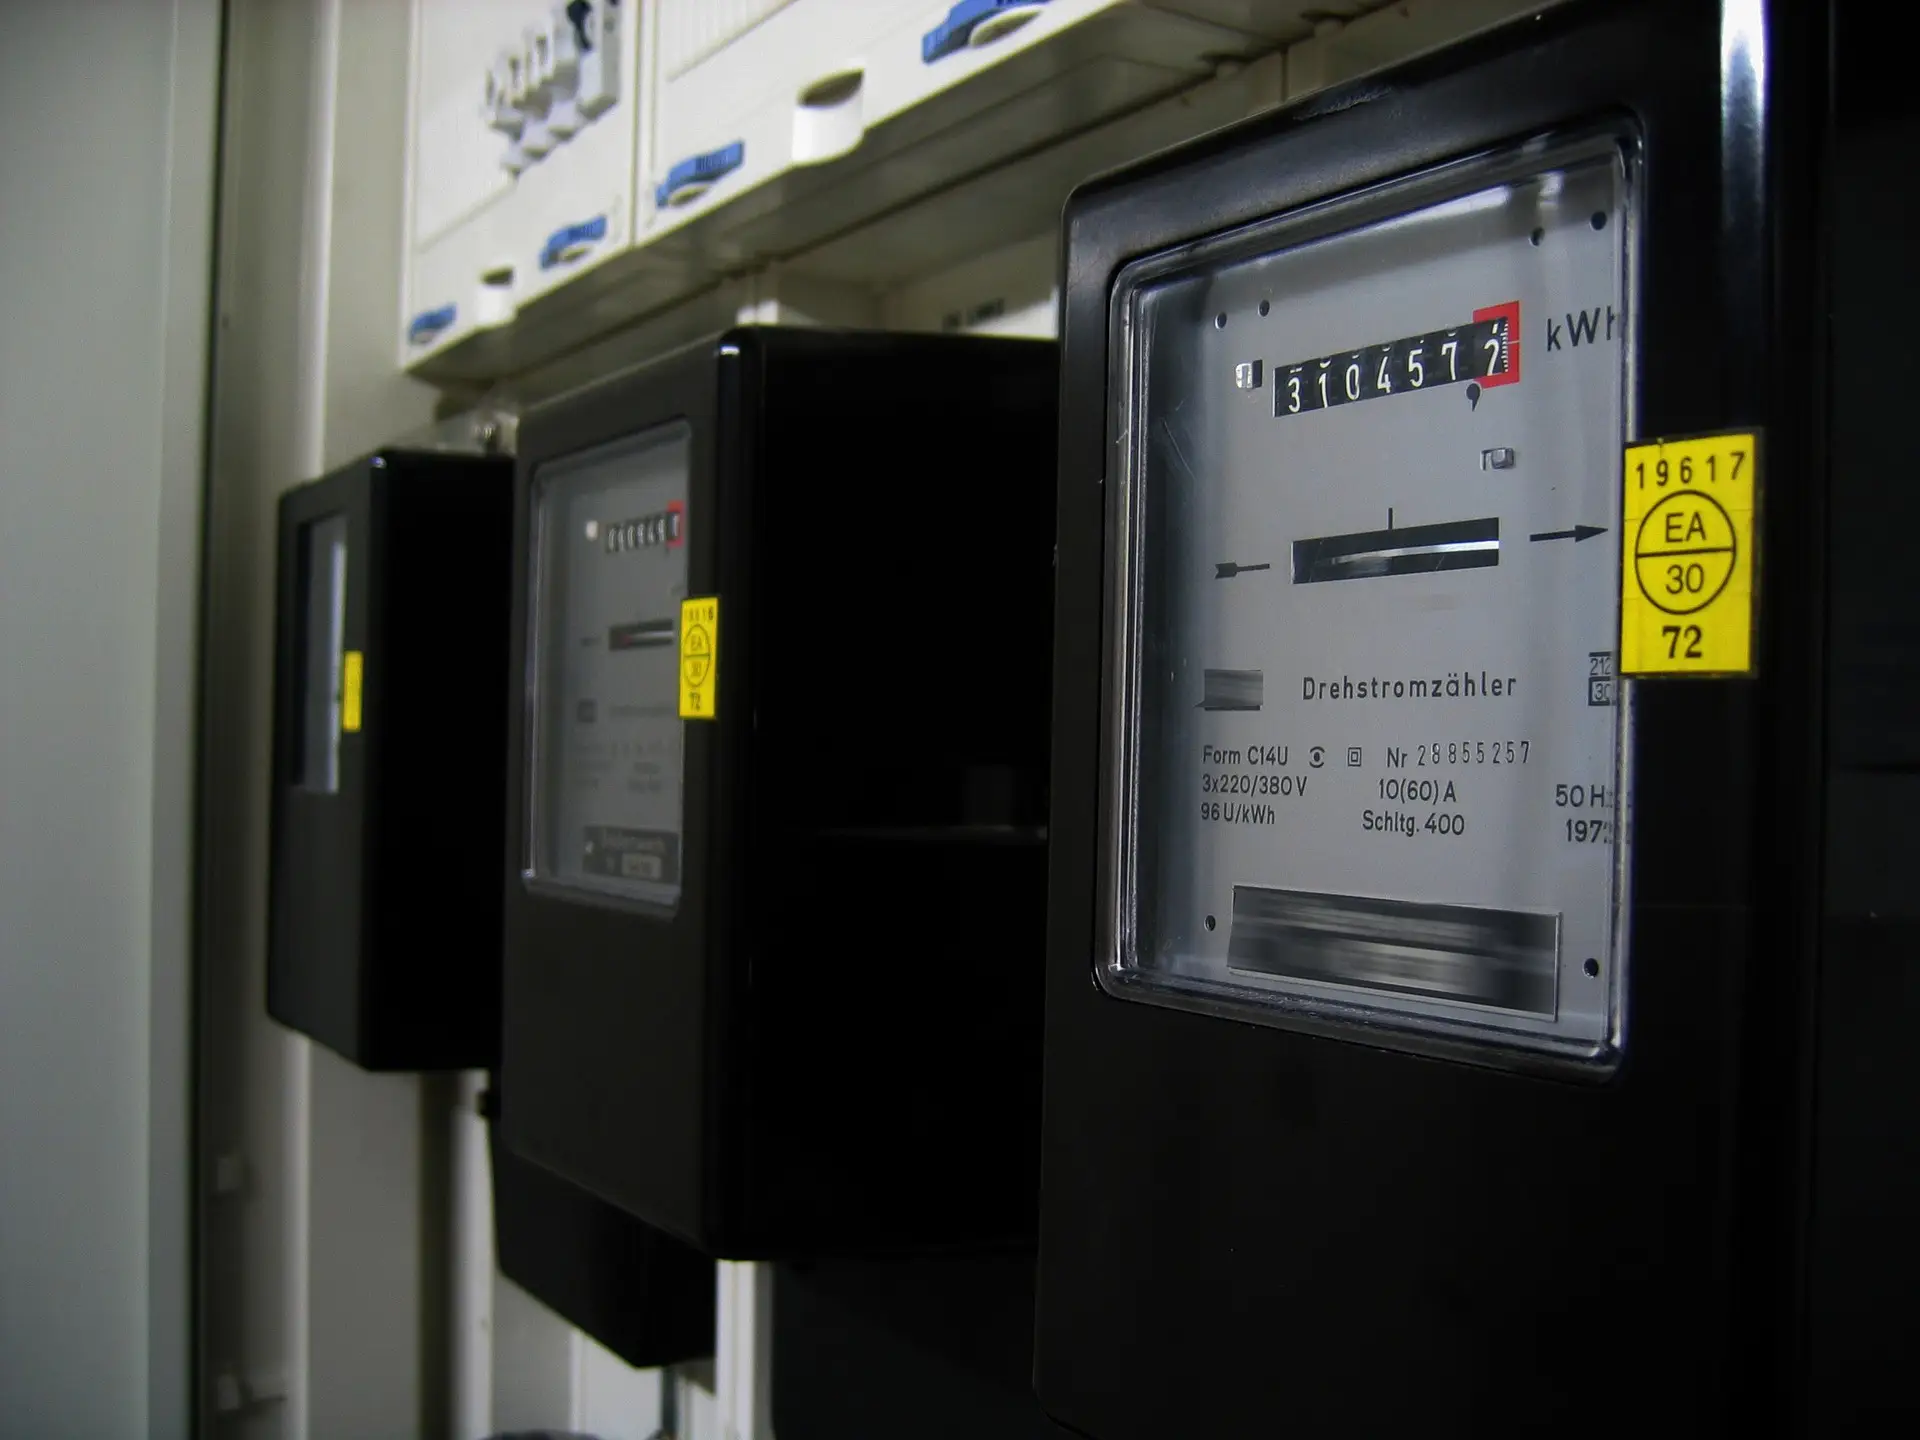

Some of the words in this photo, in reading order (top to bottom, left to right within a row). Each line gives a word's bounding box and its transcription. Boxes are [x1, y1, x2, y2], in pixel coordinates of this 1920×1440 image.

[1288, 339, 1501, 413] 3104572
[1635, 452, 1746, 490] 19617
[1664, 511, 1706, 543] EA
[1665, 563, 1704, 595] 30
[1662, 624, 1702, 659] 72
[1303, 672, 1516, 700] Drehstromzähler
[1202, 744, 1241, 764] Form
[1247, 746, 1288, 766] C14U
[1386, 747, 1408, 768] Nr
[1417, 741, 1530, 766] 28855257
[1379, 778, 1439, 805] 10(60)
[1443, 780, 1457, 802] A
[1555, 784, 1584, 808] 50
[1362, 810, 1420, 837] Schltg.
[1425, 813, 1465, 835] 400
